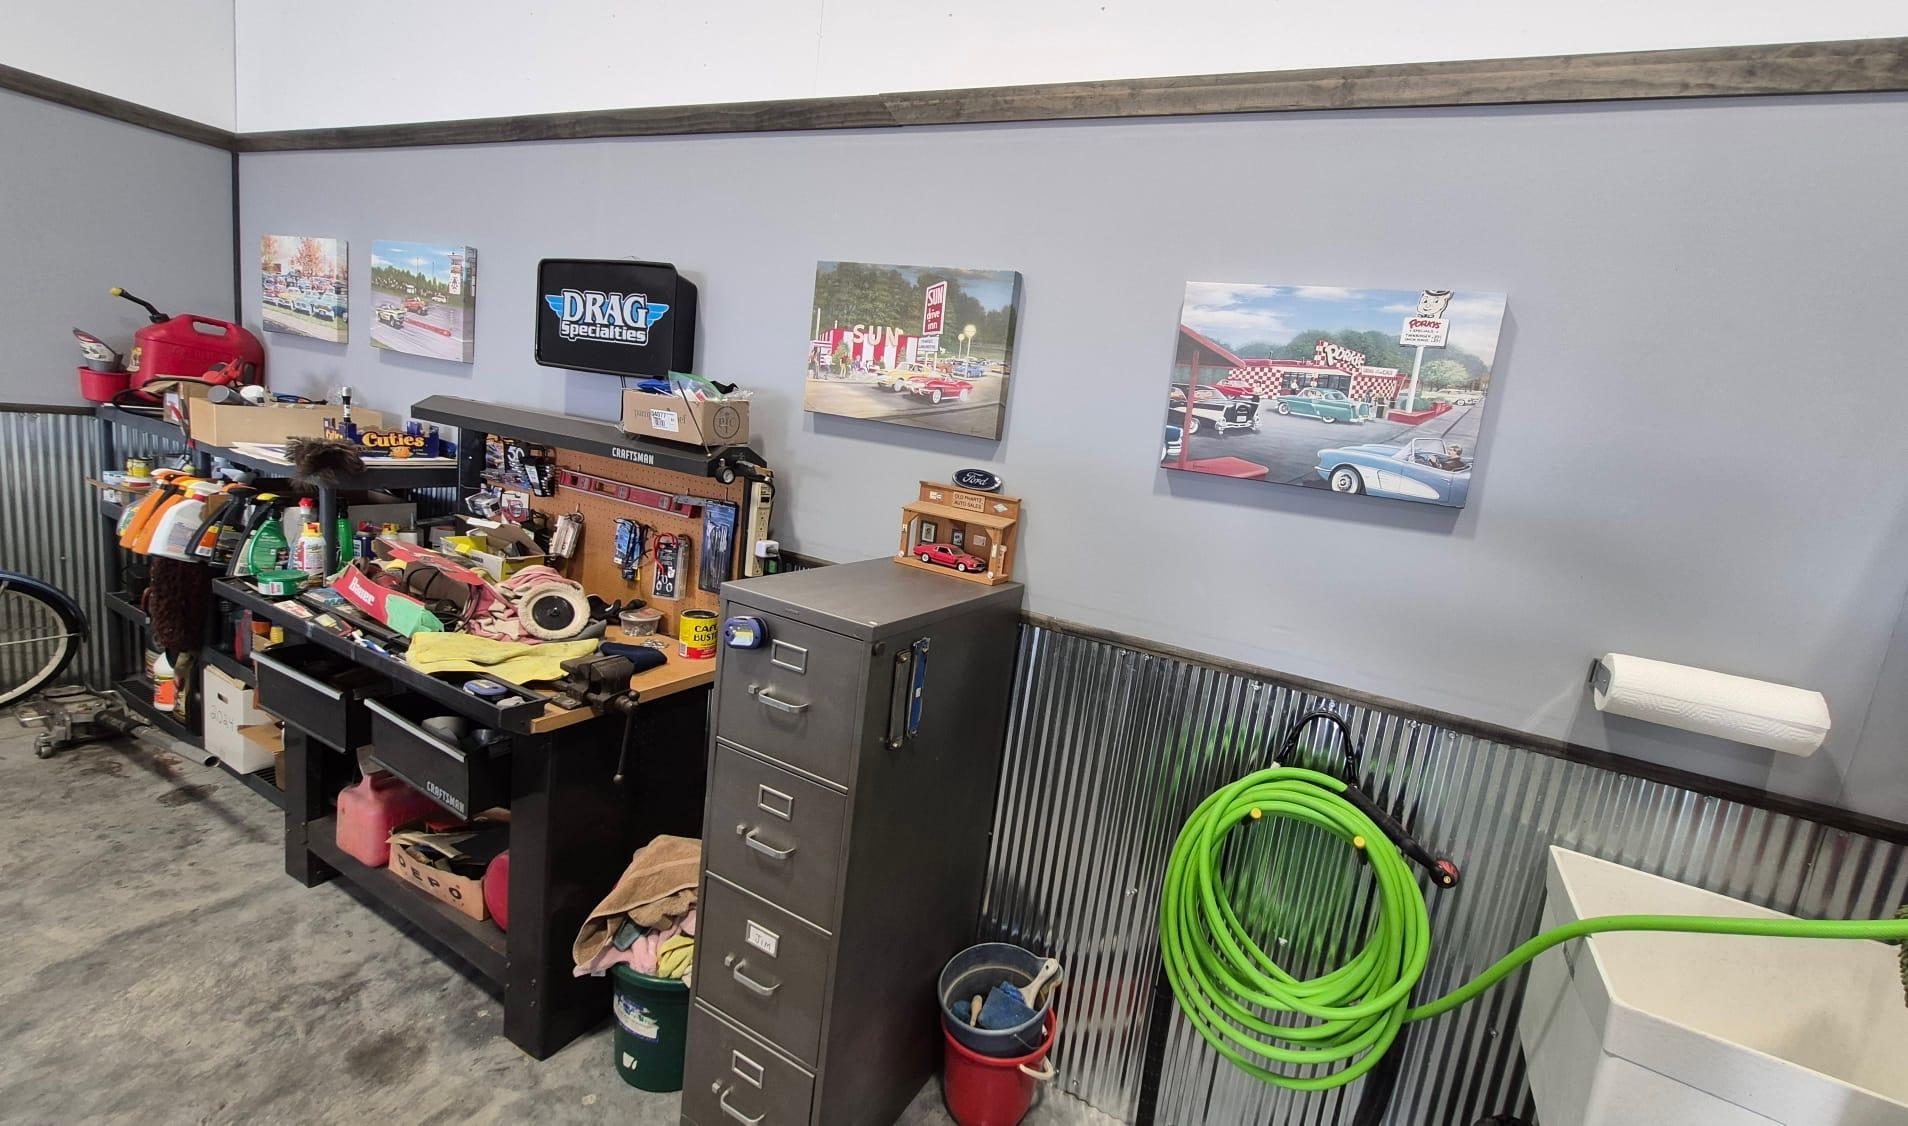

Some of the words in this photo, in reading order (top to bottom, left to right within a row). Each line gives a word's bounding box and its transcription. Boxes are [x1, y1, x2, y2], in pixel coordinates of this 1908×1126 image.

[927, 286, 944, 306] SUN
[563, 291, 648, 329] DRAG
[926, 307, 941, 321] drive
[561, 321, 647, 342] Specialties
[853, 324, 904, 347] SUN
[362, 432, 425, 448] Cuties
[612, 447, 654, 465] CRAFTSMAN
[962, 471, 990, 486] Ford
[426, 781, 465, 813] CRAFTSMAN
